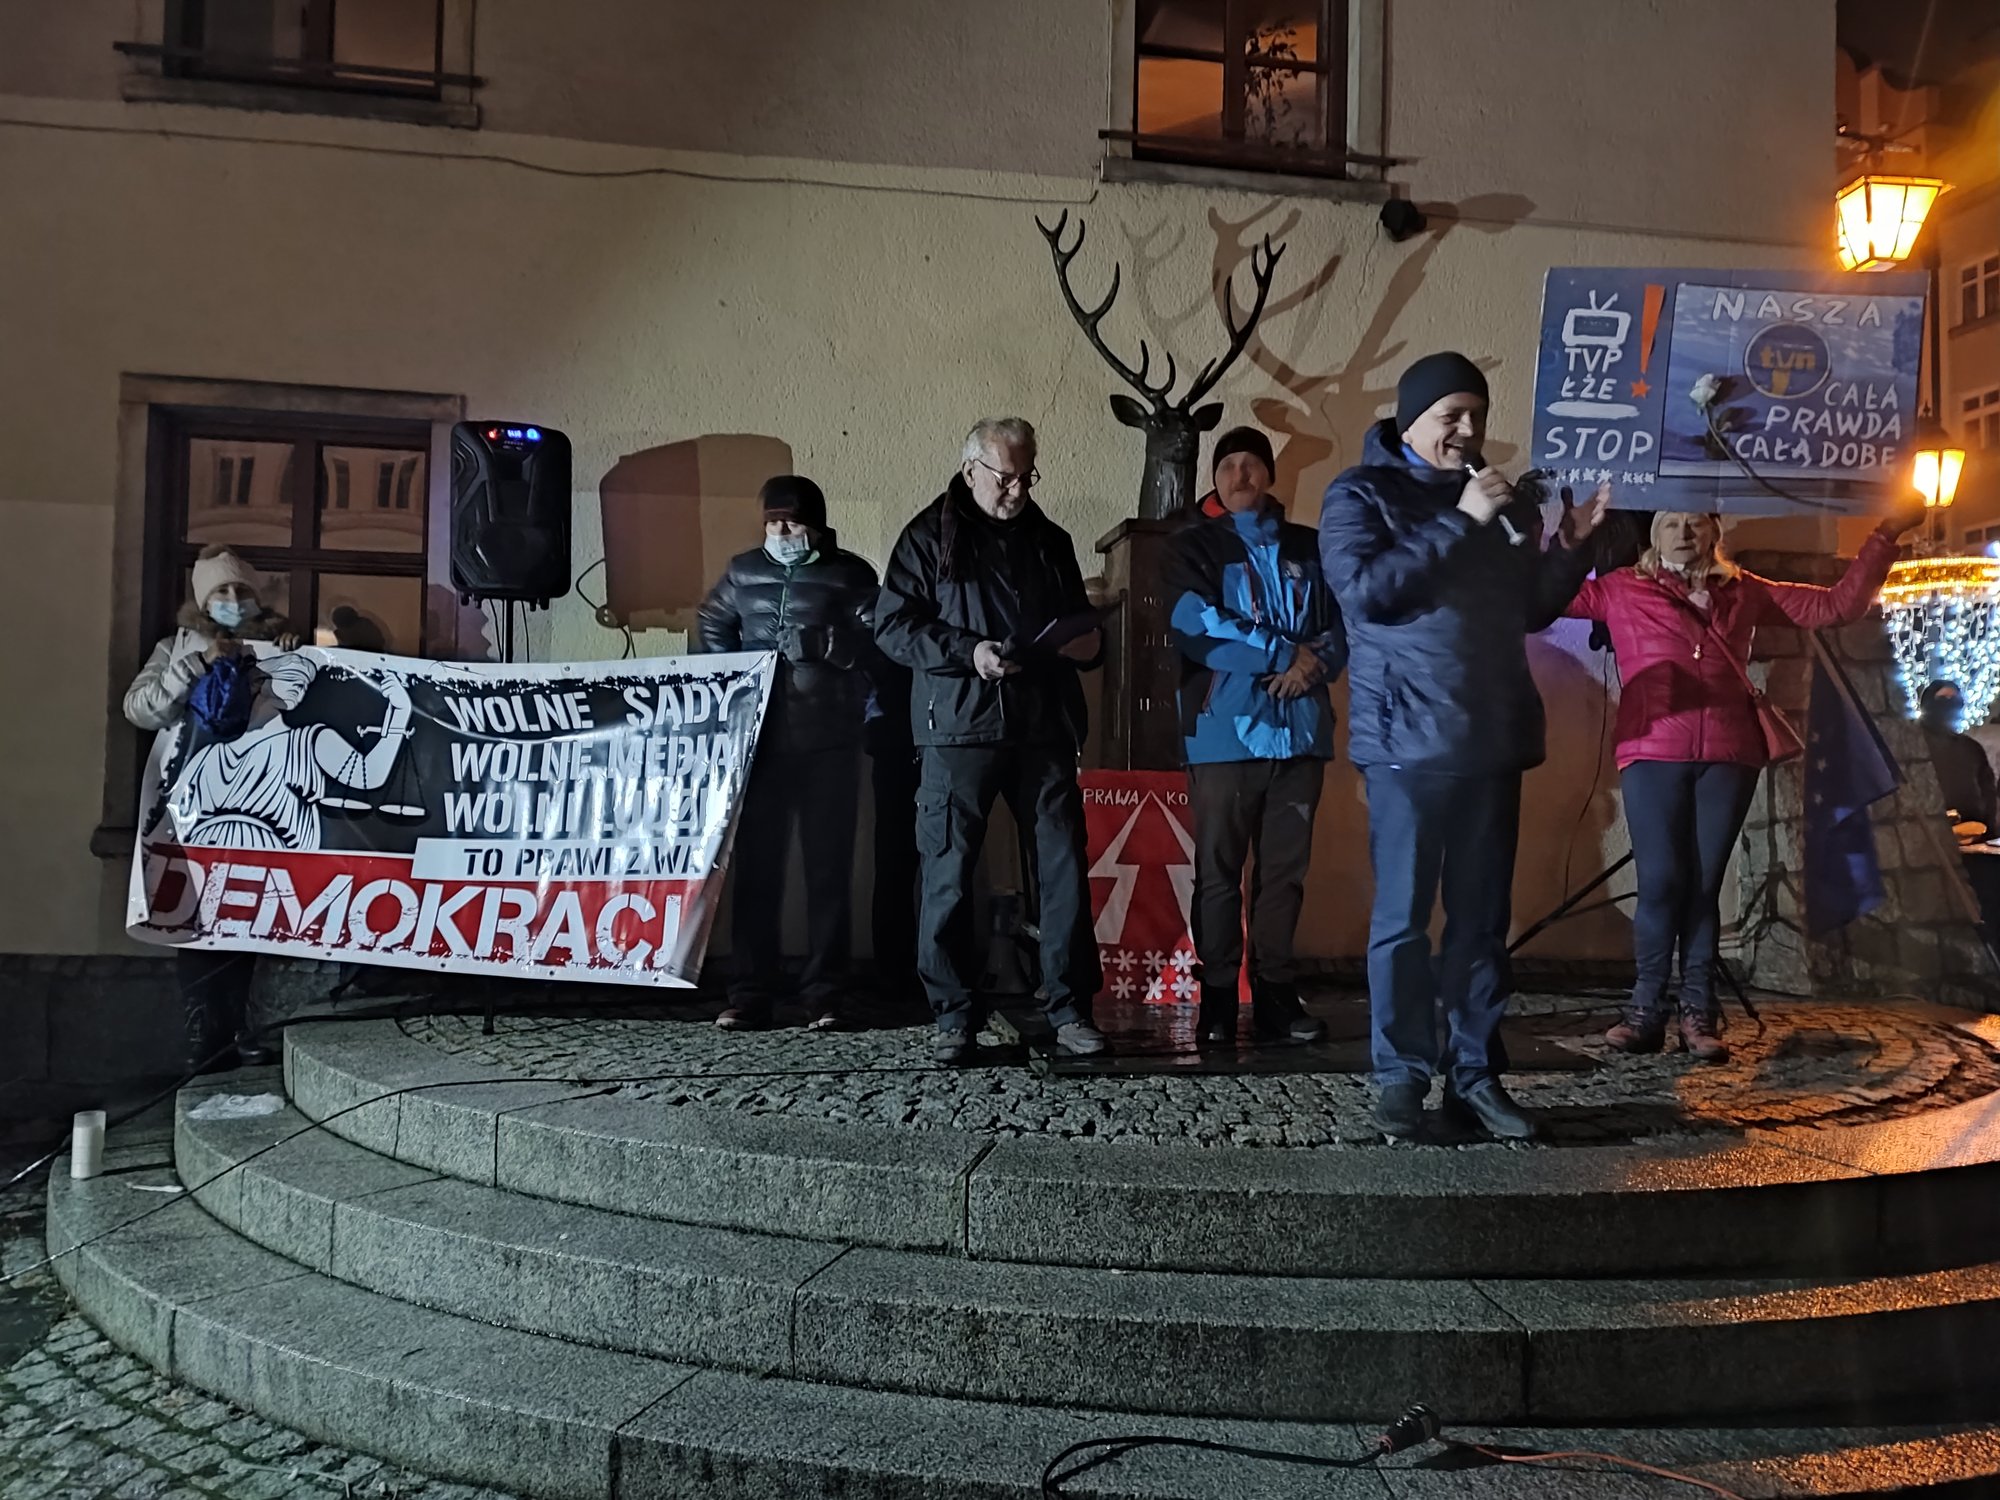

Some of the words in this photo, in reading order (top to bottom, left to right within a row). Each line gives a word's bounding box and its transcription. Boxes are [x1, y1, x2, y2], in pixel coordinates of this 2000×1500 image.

[1712, 292, 1881, 327] NASZA
[1564, 347, 1623, 373] TVP
[1561, 373, 1617, 400] ŁŻE
[1824, 382, 1899, 410] CAŁA
[1764, 405, 1901, 440] PRAWDA
[1544, 426, 1654, 463] STOP
[1735, 433, 1812, 468] CAŁĄ
[444, 691, 594, 733] WOLNE
[623, 679, 738, 732] SĄDY
[451, 740, 594, 783] WOLNE
[607, 732, 736, 779] MEDIA
[444, 792, 576, 834] WOLNI
[1083, 788, 1139, 806] PRAWA
[1166, 790, 1189, 806] KO
[464, 848, 503, 876] TO
[144, 856, 702, 969] DEMOKRACJ
